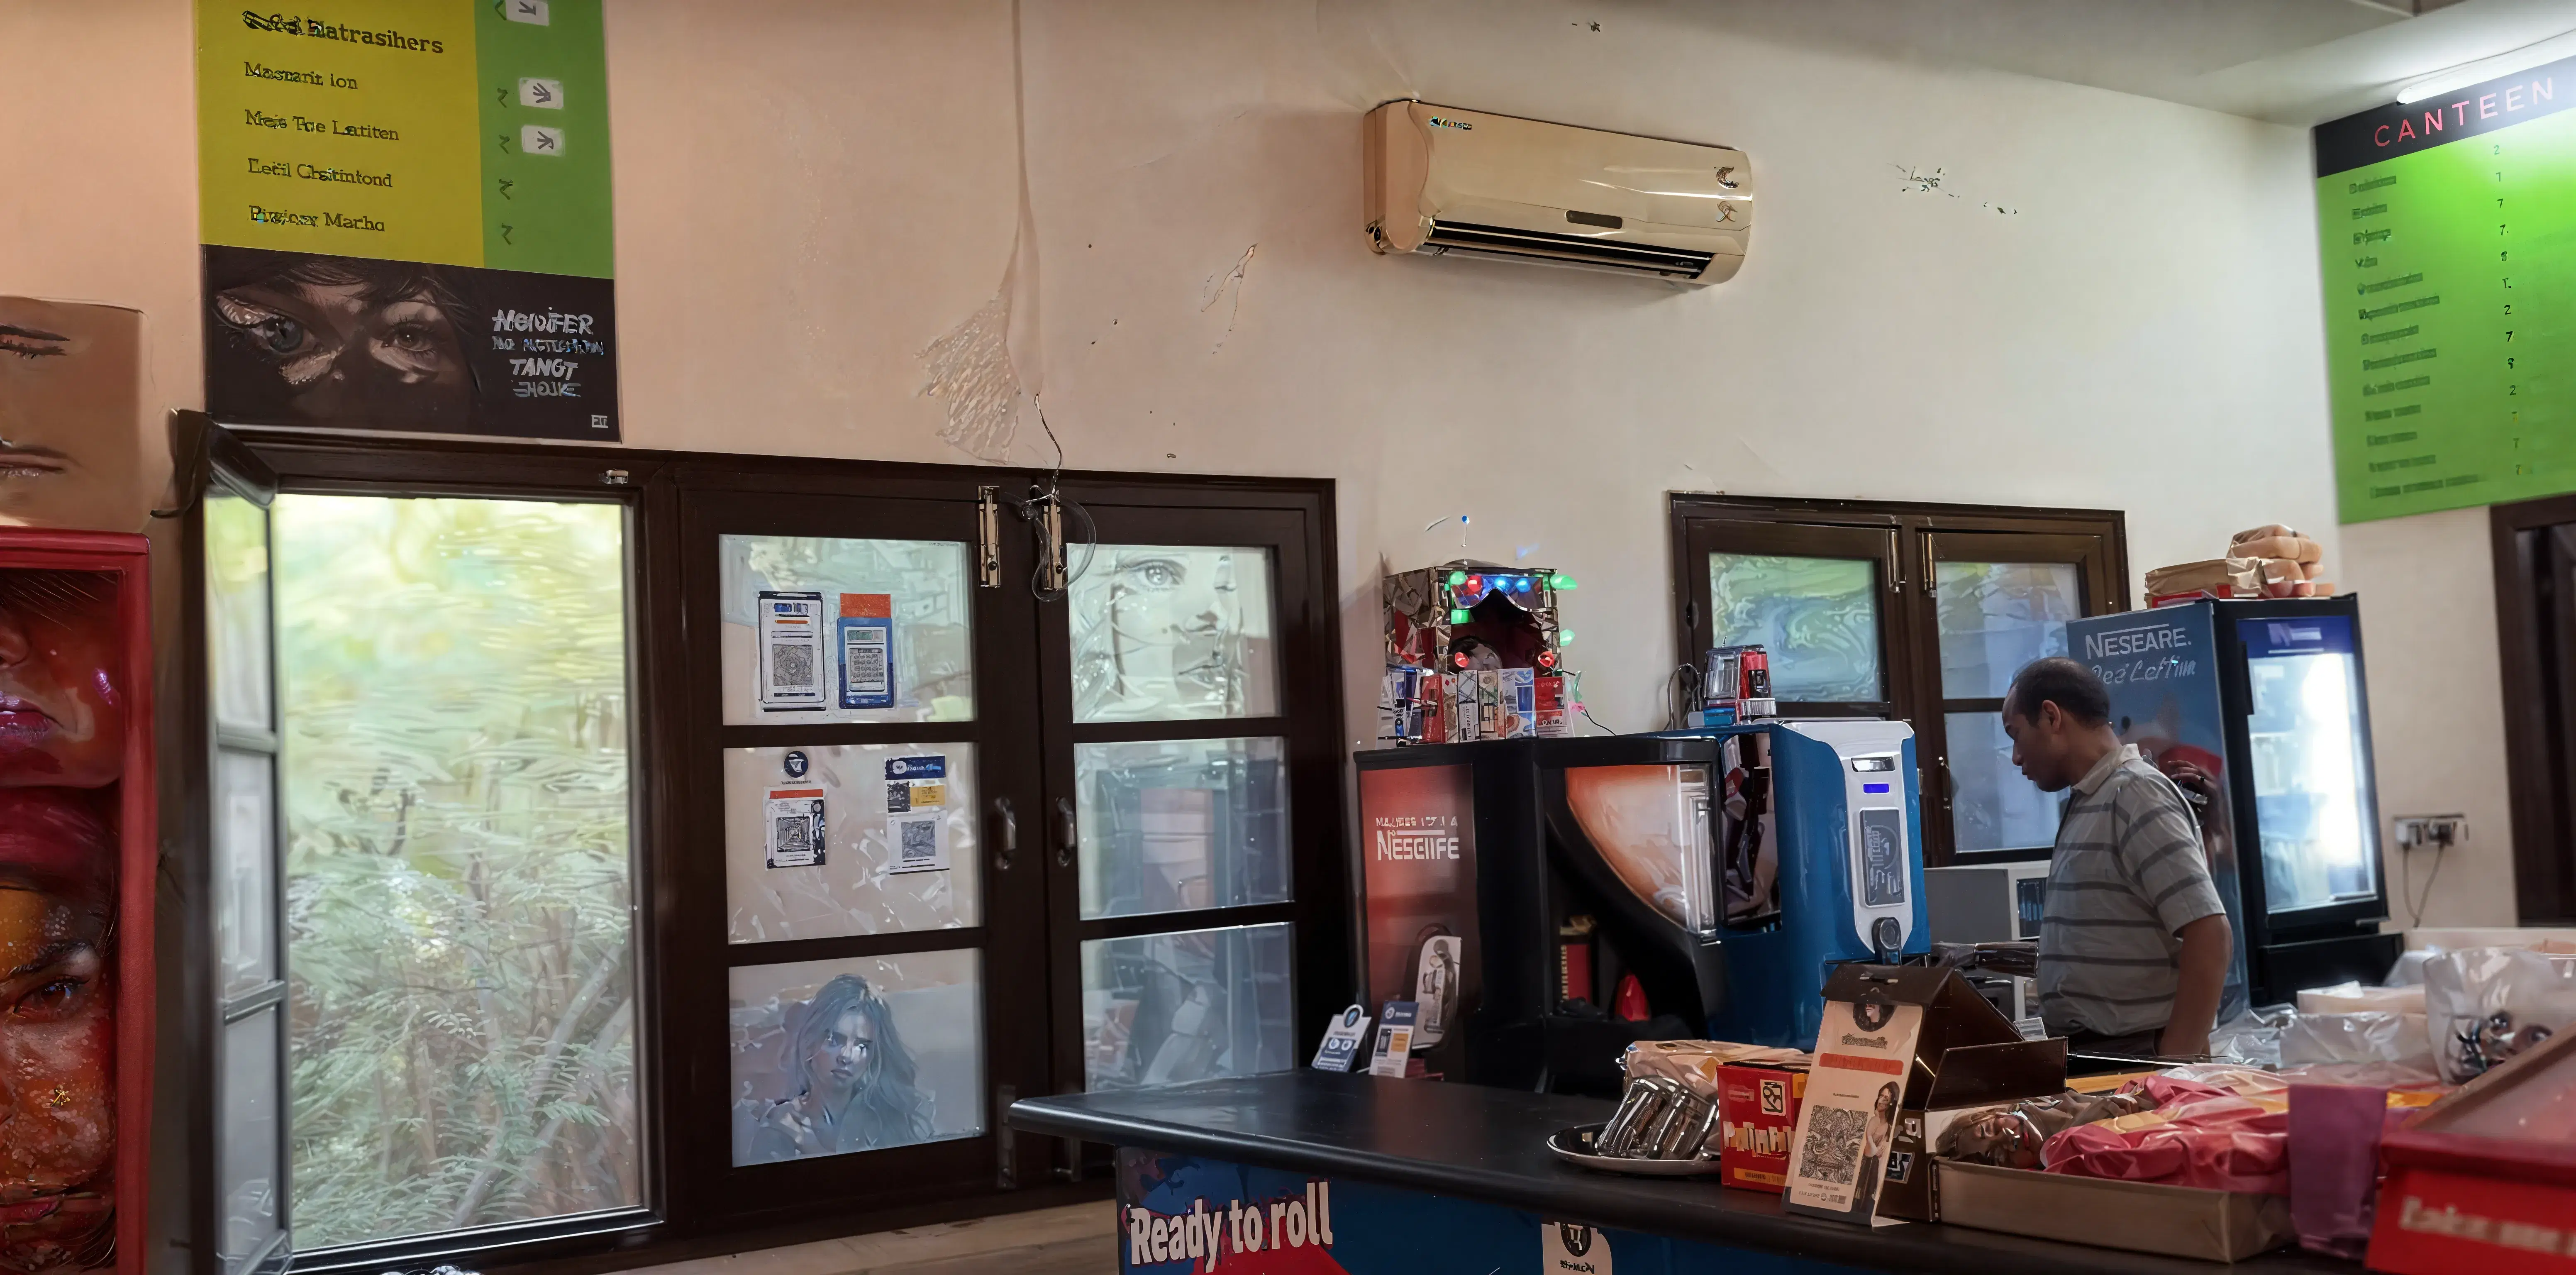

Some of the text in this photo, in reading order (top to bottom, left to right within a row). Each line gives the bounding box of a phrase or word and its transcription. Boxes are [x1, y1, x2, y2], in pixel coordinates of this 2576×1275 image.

[2374, 77, 2553, 147] CANTEEN
[1131, 1181, 1333, 1273] Ready to roll
